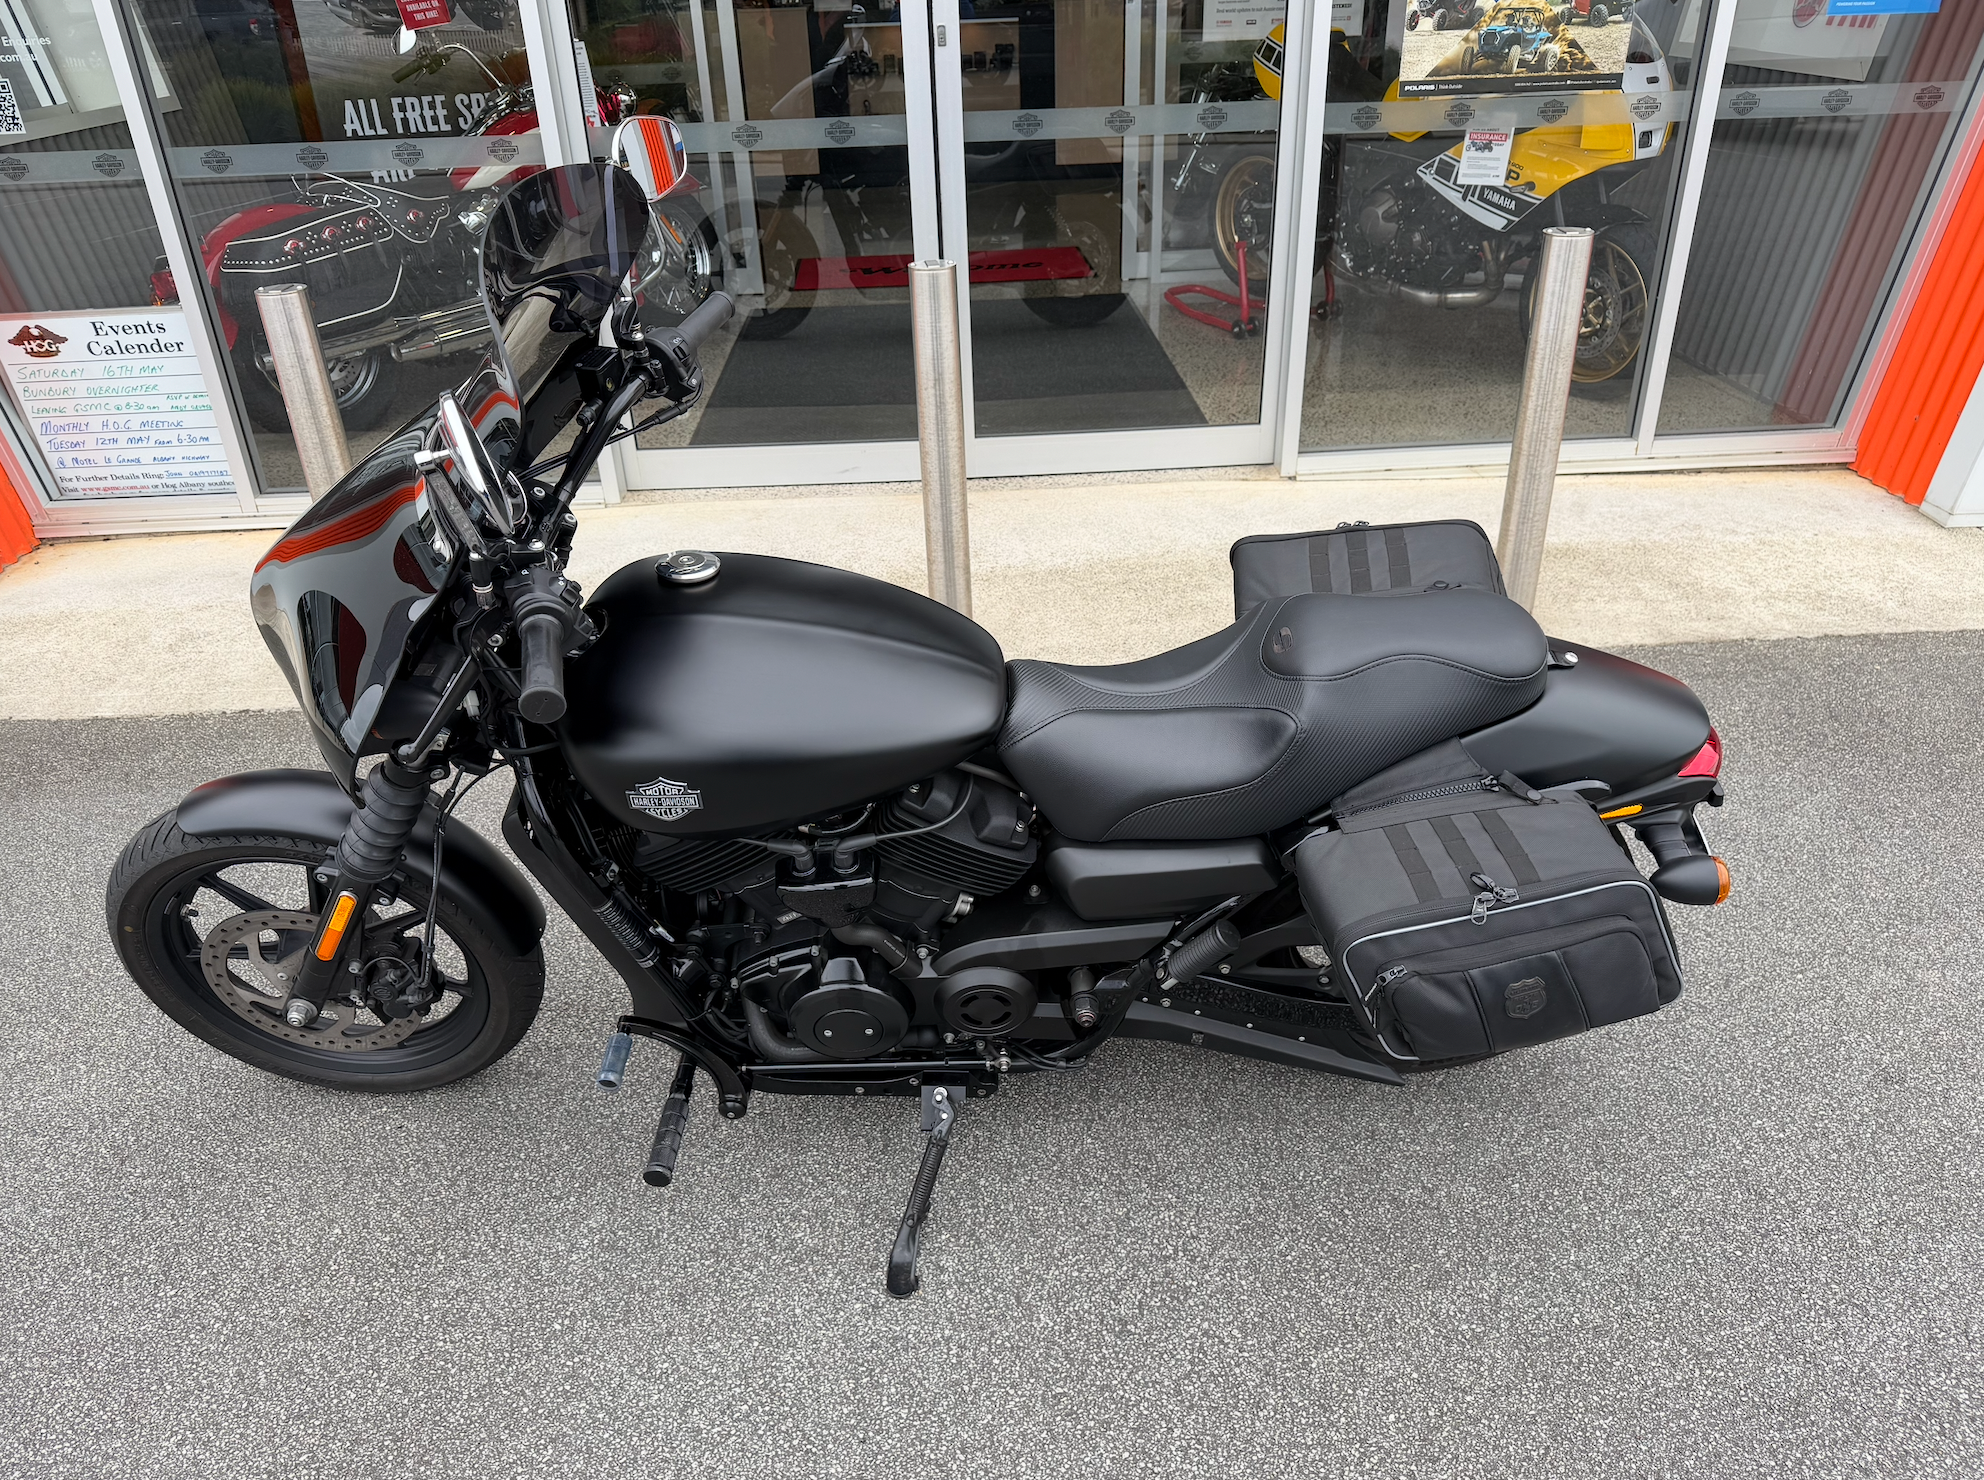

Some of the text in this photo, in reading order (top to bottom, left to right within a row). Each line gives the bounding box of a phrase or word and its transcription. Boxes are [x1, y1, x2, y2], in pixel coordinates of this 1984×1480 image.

[1, 36, 52, 49] Enquiries
[1404, 84, 1436, 92] POLARIS
[343, 92, 493, 137] ALL FREE SP
[1470, 133, 1507, 141] INSURANCE
[1483, 187, 1516, 211] YAMAHA
[89, 320, 167, 337] Events
[86, 338, 185, 357] Calender
[16, 364, 165, 380] SATURDAY 16TH MAY
[22, 383, 160, 398] BUNBURY OVERNIGHTER
[40, 421, 90, 433] MONTHLY
[139, 420, 184, 429] MEETING
[46, 437, 86, 451] TUESDAY
[95, 437, 119, 446] 12TH
[126, 435, 151, 445] MAY
[71, 456, 98, 466] MOTEL
[59, 470, 165, 484] For Further Details Ring:
[61, 484, 80, 494] Visit
[161, 481, 177, 491] Hog
[178, 480, 206, 490] Albany
[645, 786, 681, 796] MOTOR
[633, 797, 696, 806] HARLEY-DAVIDSON
